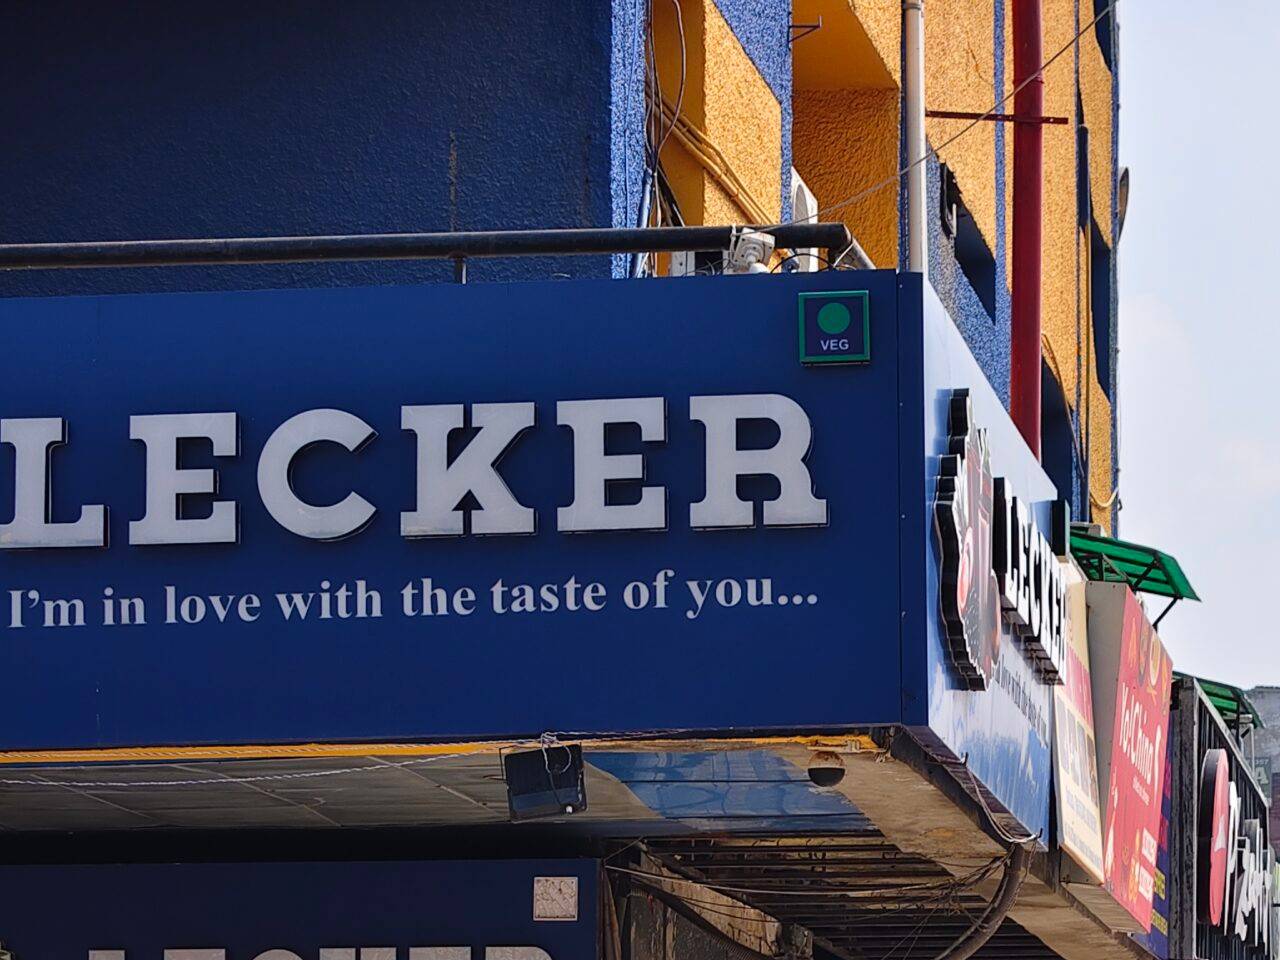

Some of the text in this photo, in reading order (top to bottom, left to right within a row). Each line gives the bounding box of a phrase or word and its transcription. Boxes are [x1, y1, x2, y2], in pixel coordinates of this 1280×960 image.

[820, 338, 849, 350] VEG
[0, 394, 829, 549] LECKER
[102, 587, 147, 625] in
[164, 585, 261, 624] love
[275, 579, 383, 621] with
[400, 578, 476, 616] the
[489, 574, 607, 614] taste
[623, 569, 675, 609] of
[686, 577, 818, 619] you...
